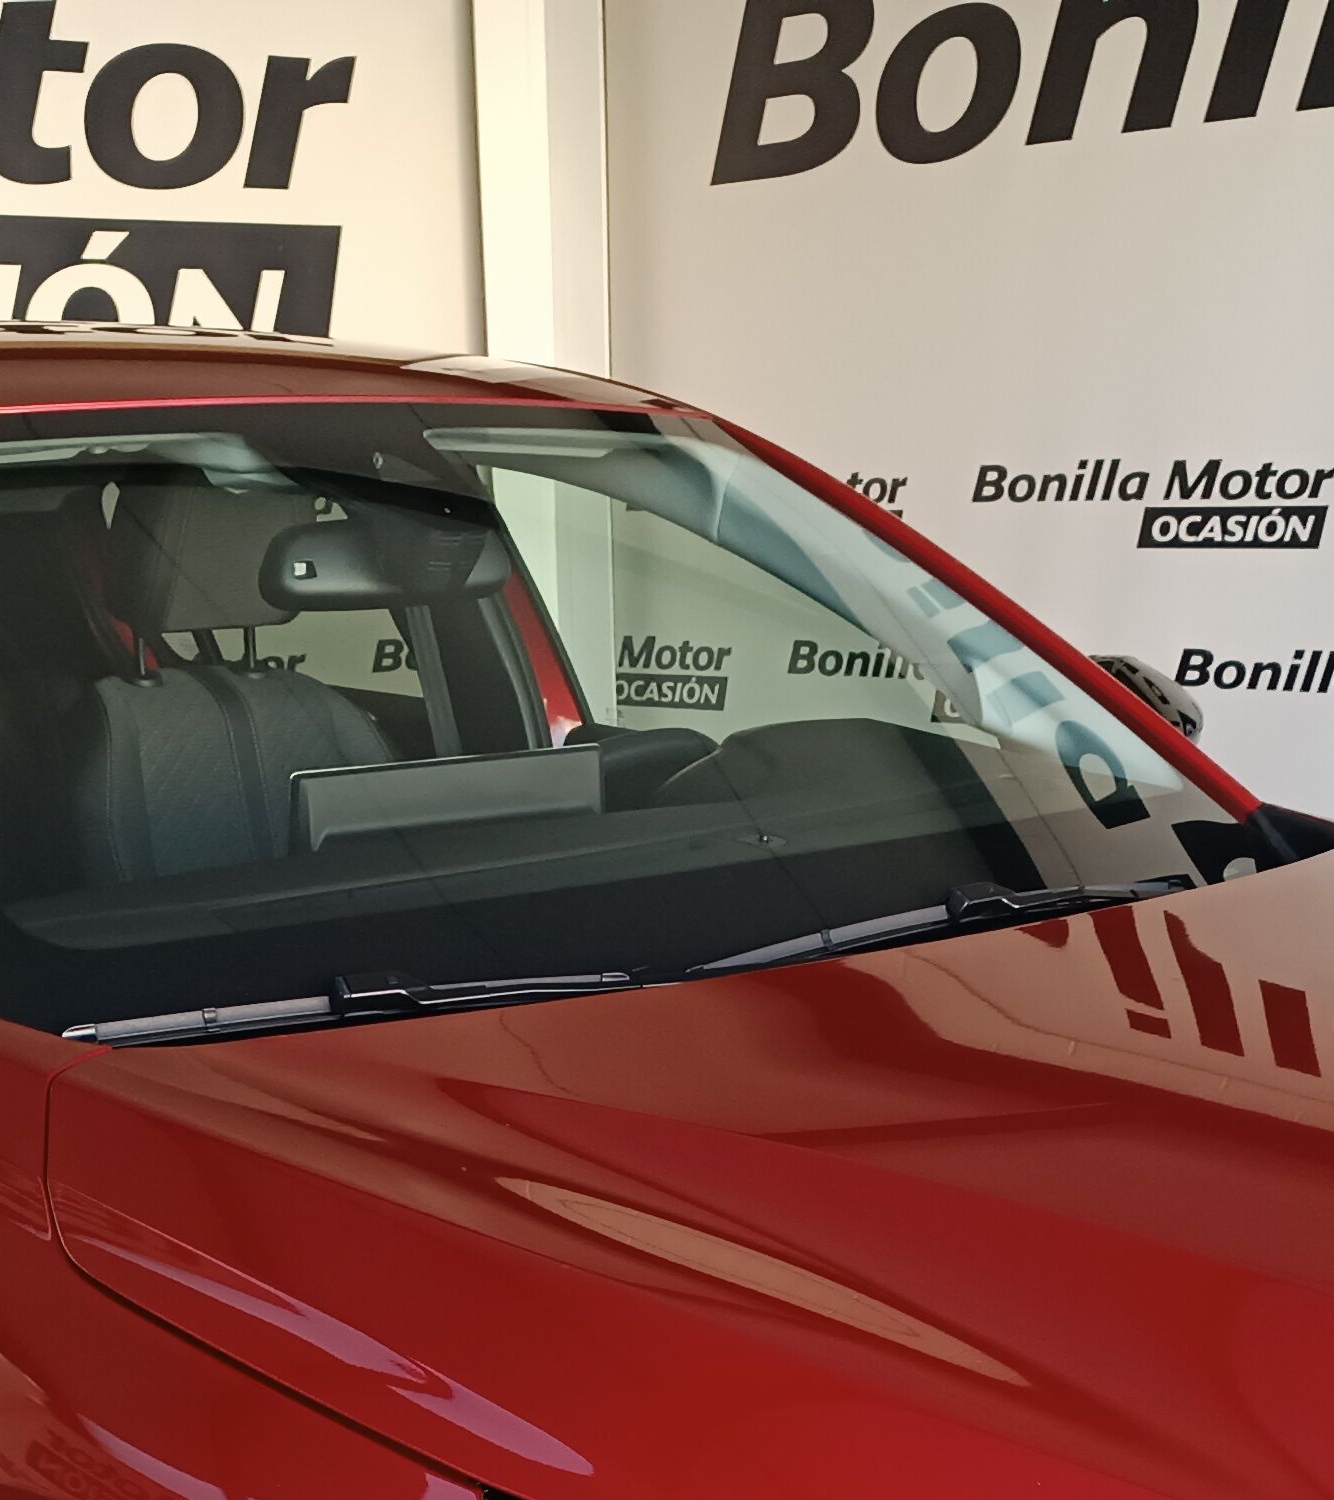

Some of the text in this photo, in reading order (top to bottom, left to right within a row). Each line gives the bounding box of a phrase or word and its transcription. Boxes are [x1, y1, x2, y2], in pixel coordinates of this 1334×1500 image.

[971, 458, 1150, 503] Bonilla
[1150, 509, 1315, 543] OCASIÓN
[617, 635, 733, 671] Motor
[616, 676, 720, 704] OCASIÓN
